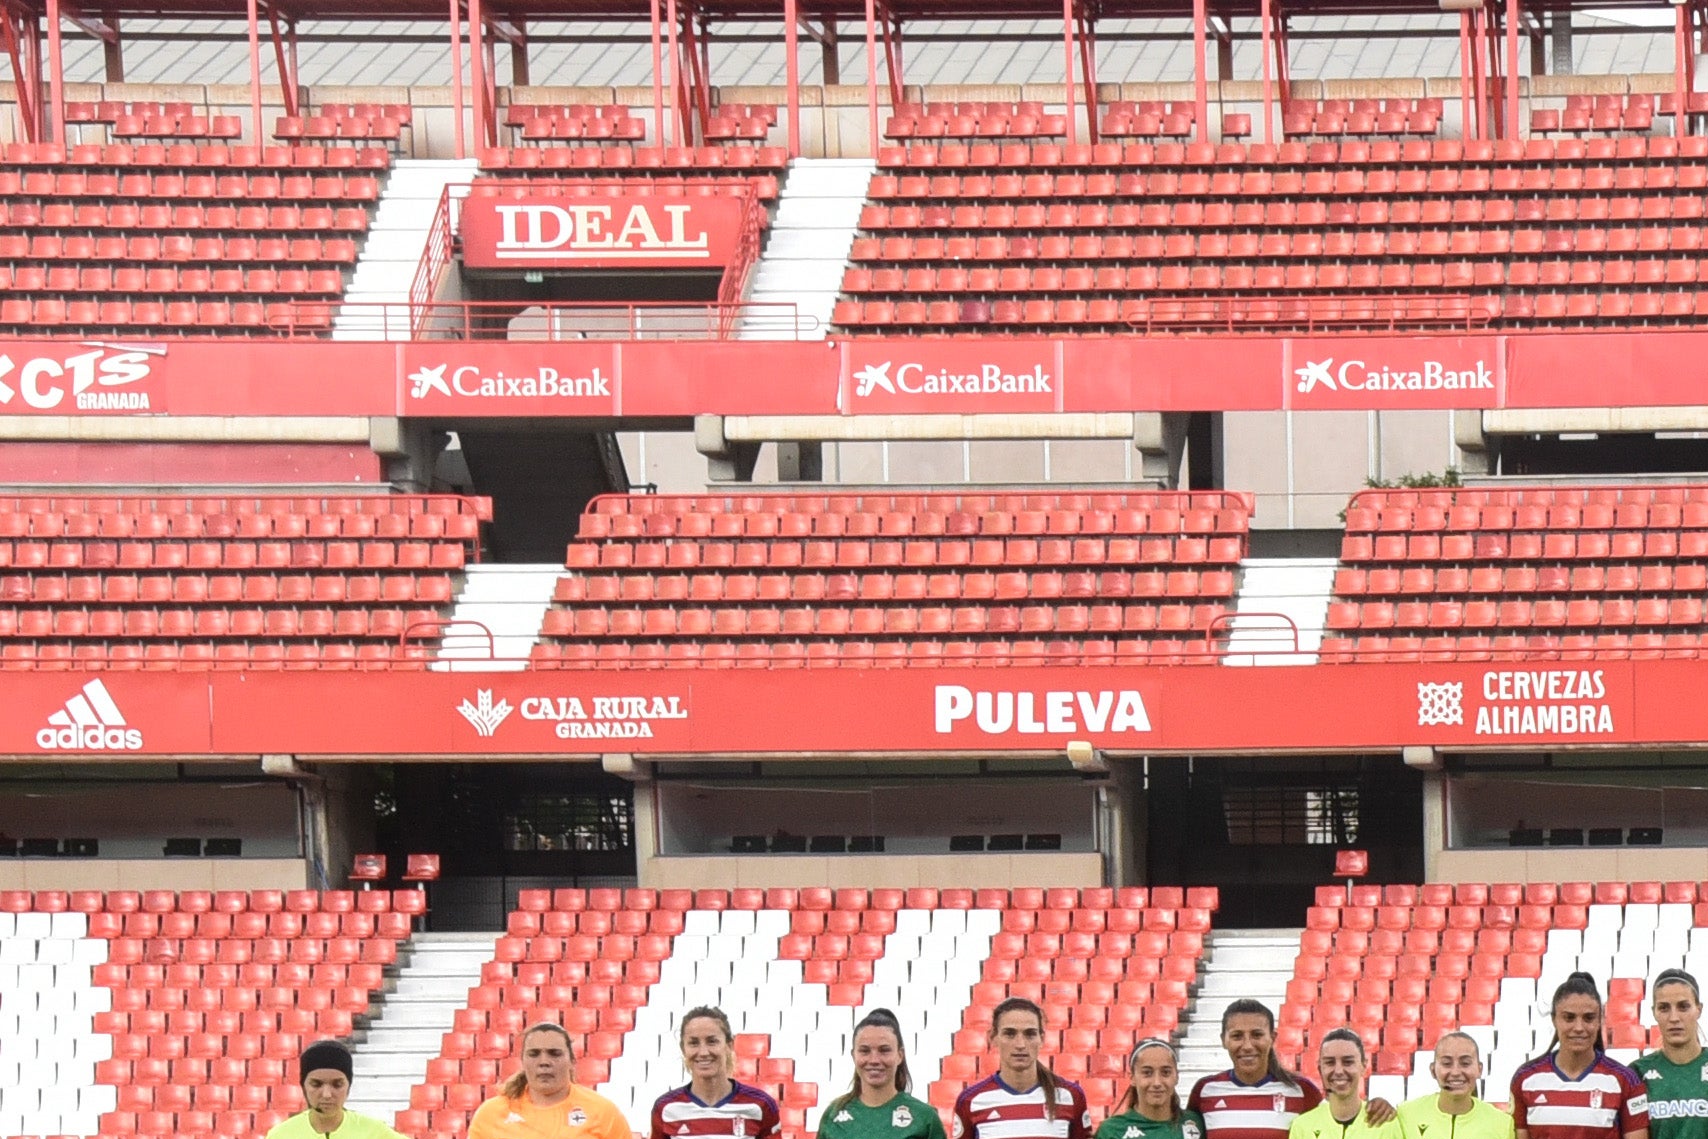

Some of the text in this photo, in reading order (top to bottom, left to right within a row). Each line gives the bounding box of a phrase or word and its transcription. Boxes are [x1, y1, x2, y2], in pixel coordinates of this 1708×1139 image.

[495, 204, 709, 249] IDEAL
[452, 366, 610, 398] CaixaBank
[896, 363, 1053, 394] CaixaBank
[1338, 360, 1495, 391] CaixaBank
[76, 392, 150, 410] GRANADA
[1483, 670, 1605, 700] CERVEZAS
[520, 696, 688, 722] CAJA RURAL
[935, 685, 1152, 734] PULEVA
[1475, 704, 1614, 735] ALHAMBRA
[36, 724, 143, 750] adidas
[555, 721, 653, 739] GRANADA
